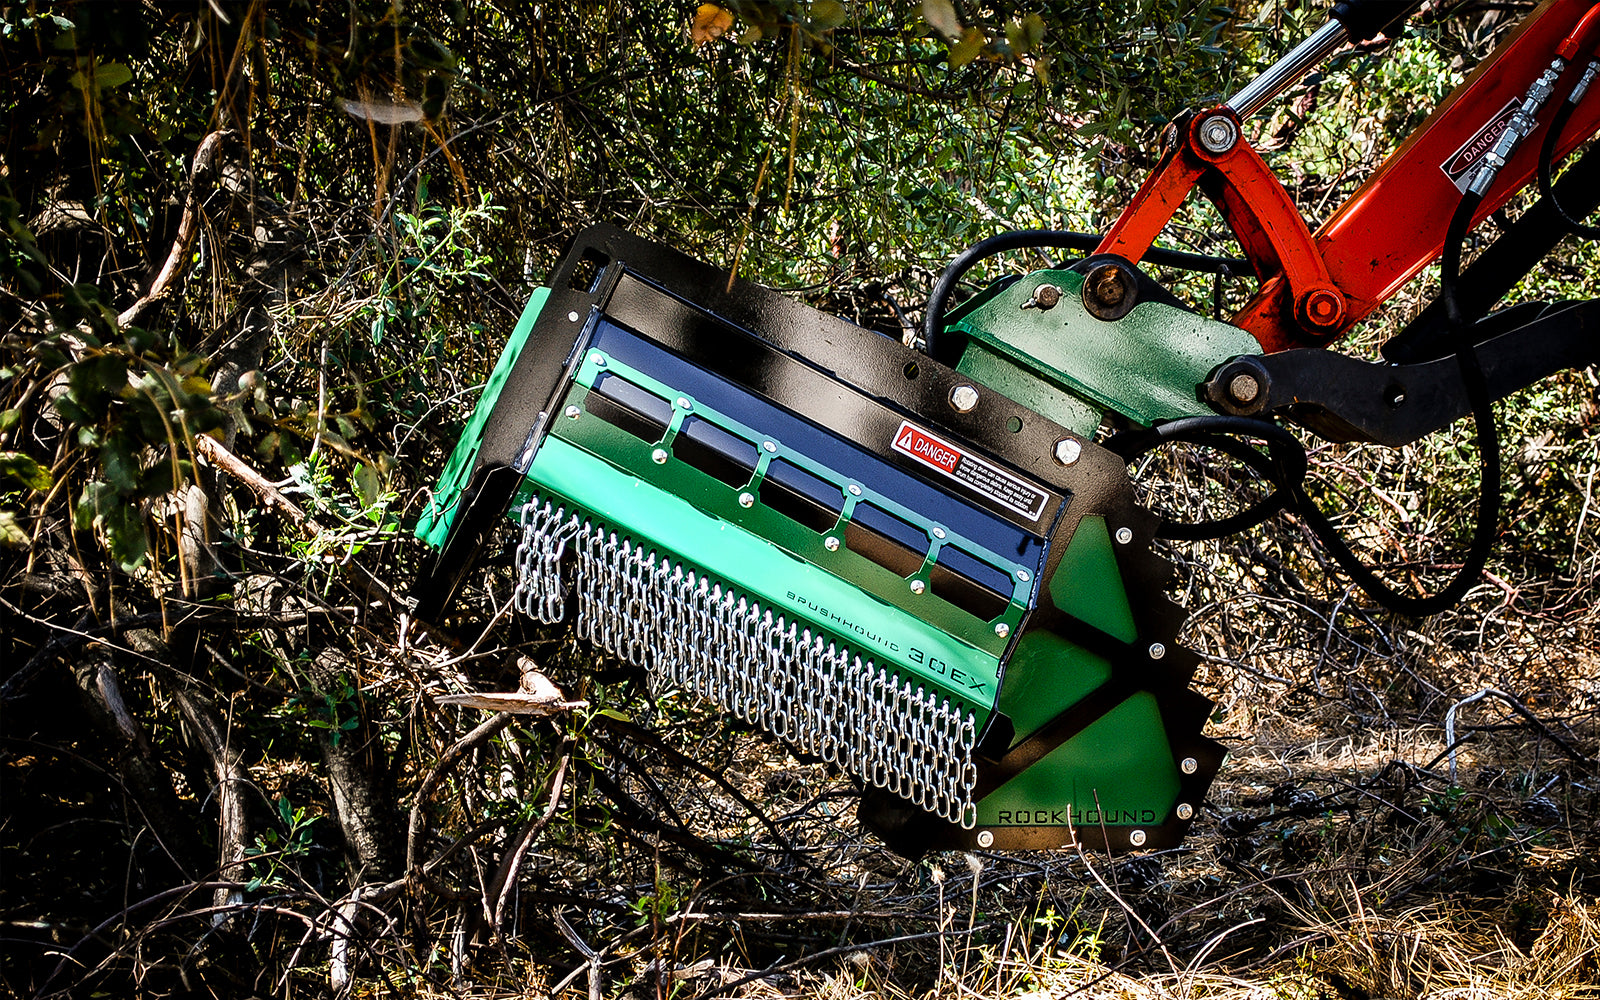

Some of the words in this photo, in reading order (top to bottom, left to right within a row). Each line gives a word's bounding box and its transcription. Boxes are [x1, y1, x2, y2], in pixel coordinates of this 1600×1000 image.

[1463, 120, 1506, 162] DANGER
[914, 437, 957, 469] DANGER
[955, 470, 966, 479] drum
[974, 479, 994, 493] completely
[994, 489, 1009, 501] stopped
[962, 457, 978, 470] Rotating
[978, 464, 988, 475] drum
[995, 475, 1007, 484] cause
[1020, 487, 1031, 498] injury
[970, 469, 990, 483] dangerous
[1003, 486, 1013, 497] Keep
[1013, 492, 1023, 502] away
[786, 591, 900, 652] BRUSHHOUND
[908, 647, 986, 695] 30EX
[998, 809, 1156, 824] ROCKHOUND
